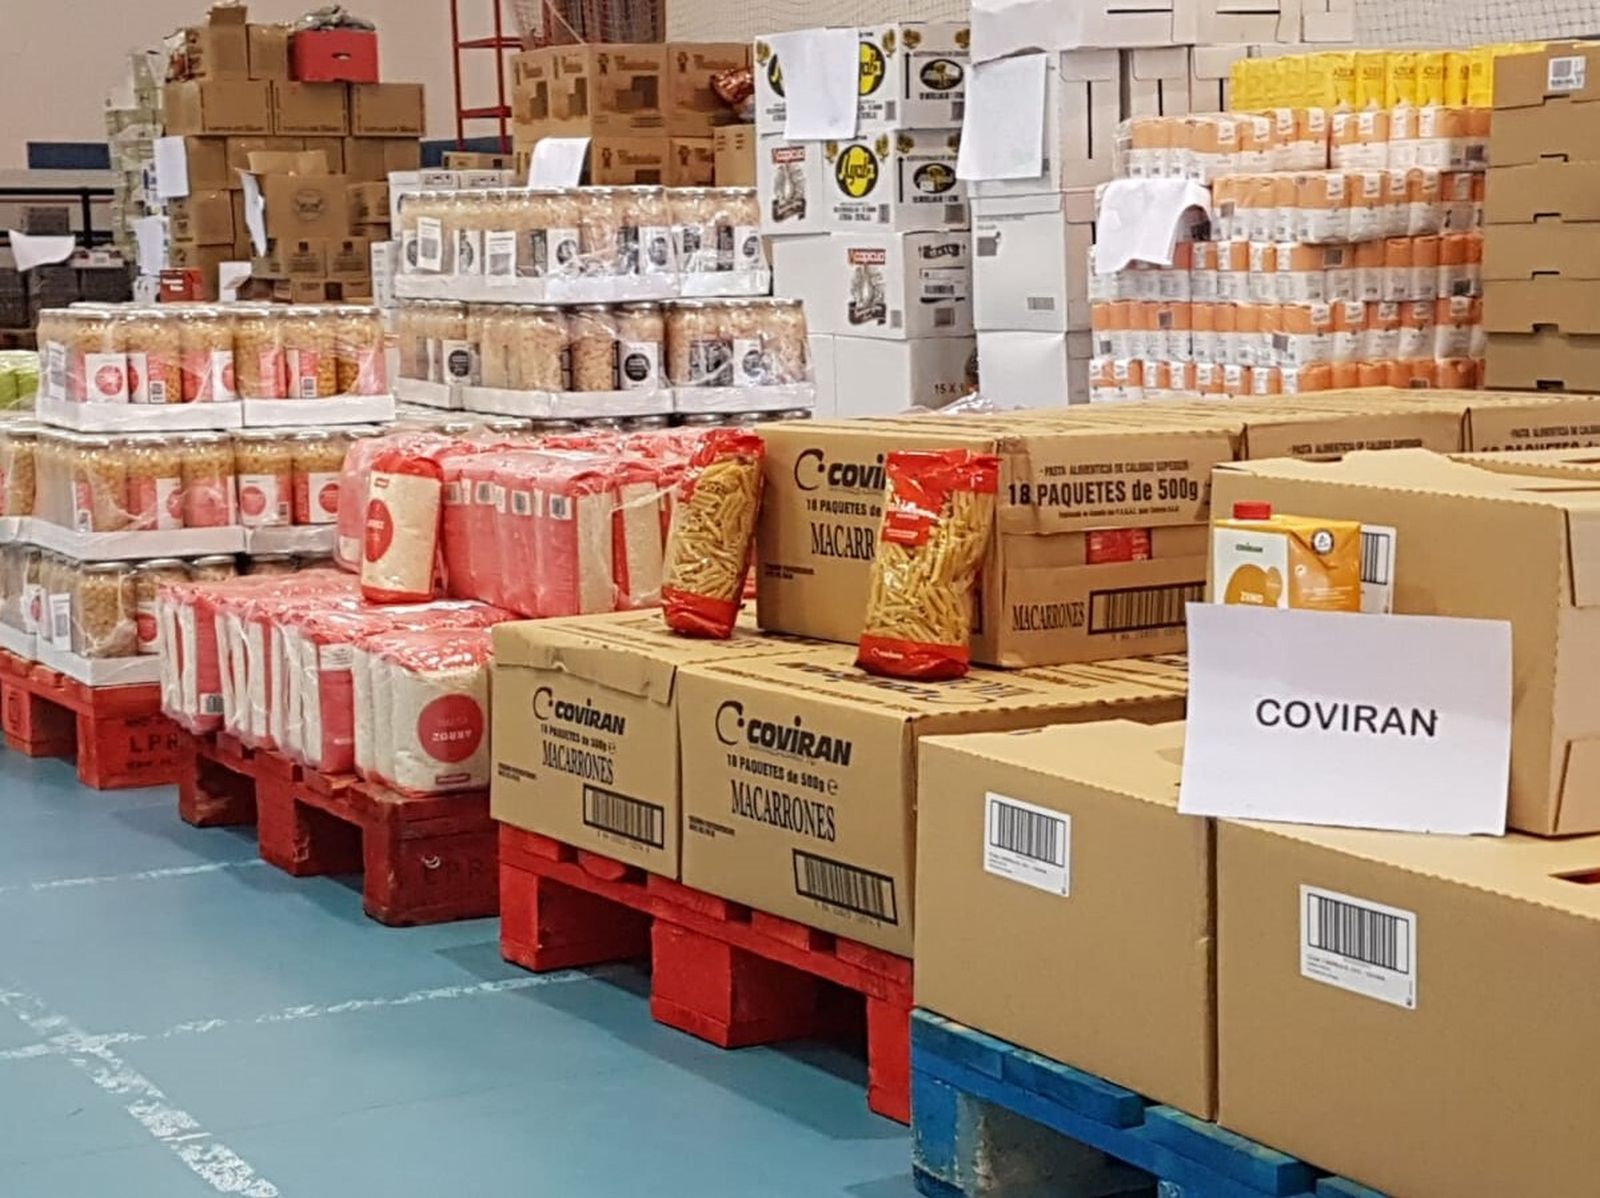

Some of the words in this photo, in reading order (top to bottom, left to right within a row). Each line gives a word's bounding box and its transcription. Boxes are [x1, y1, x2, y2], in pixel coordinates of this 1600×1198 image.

[827, 454, 886, 490] COVI
[819, 499, 867, 517] PAQUETES
[869, 502, 882, 518] de
[1008, 483, 1031, 506] 18
[1037, 480, 1126, 508] PAQUETES
[1132, 479, 1153, 502] de
[1158, 477, 1199, 501] 500g
[810, 521, 876, 561] MACARR
[1012, 601, 1085, 631] MACARRONES
[1256, 698, 1438, 737] COVIRAN
[542, 739, 614, 786] MACARRONES
[739, 755, 785, 781] PAQUETES
[787, 769, 799, 784] de
[801, 772, 825, 794] 500g
[730, 779, 837, 843] MACARRONES
